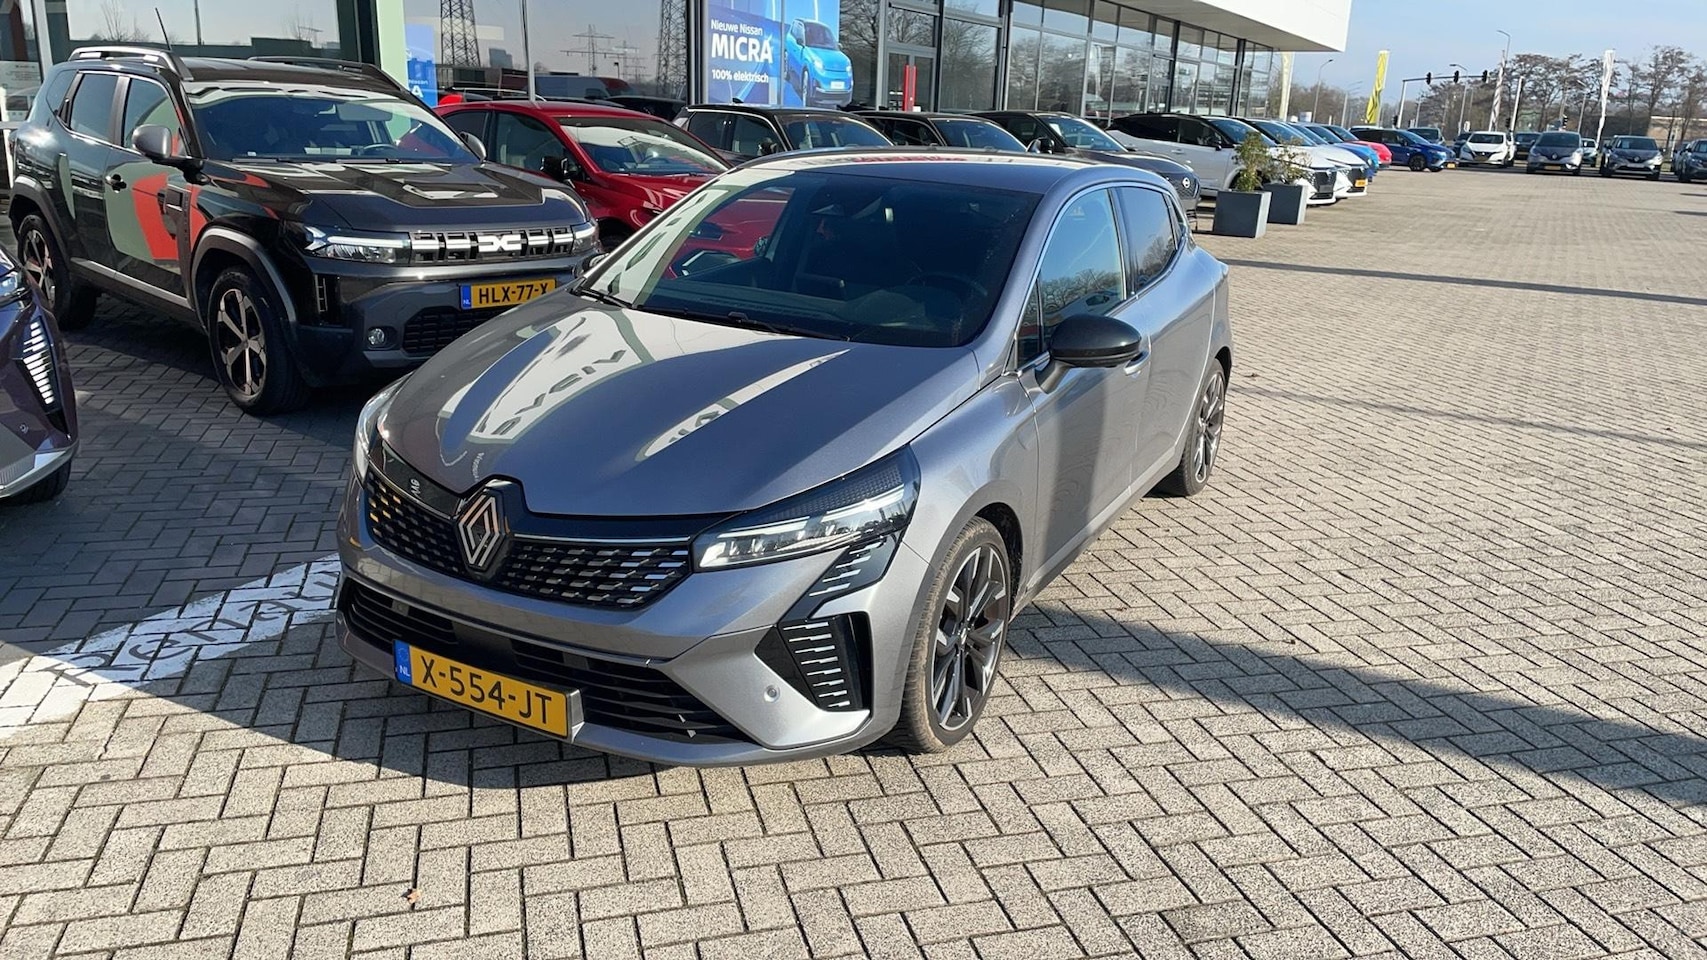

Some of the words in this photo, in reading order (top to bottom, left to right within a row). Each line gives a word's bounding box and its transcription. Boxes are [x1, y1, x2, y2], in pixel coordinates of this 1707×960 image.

[711, 19, 738, 32] Nieuwe
[739, 23, 763, 36] Nissan
[711, 33, 773, 64] MICRA
[711, 69, 732, 81] 100%
[733, 70, 769, 83] elektrisch
[479, 283, 549, 304] HLX-77-X
[399, 665, 411, 677] NL
[421, 655, 552, 724] X-554-JT
